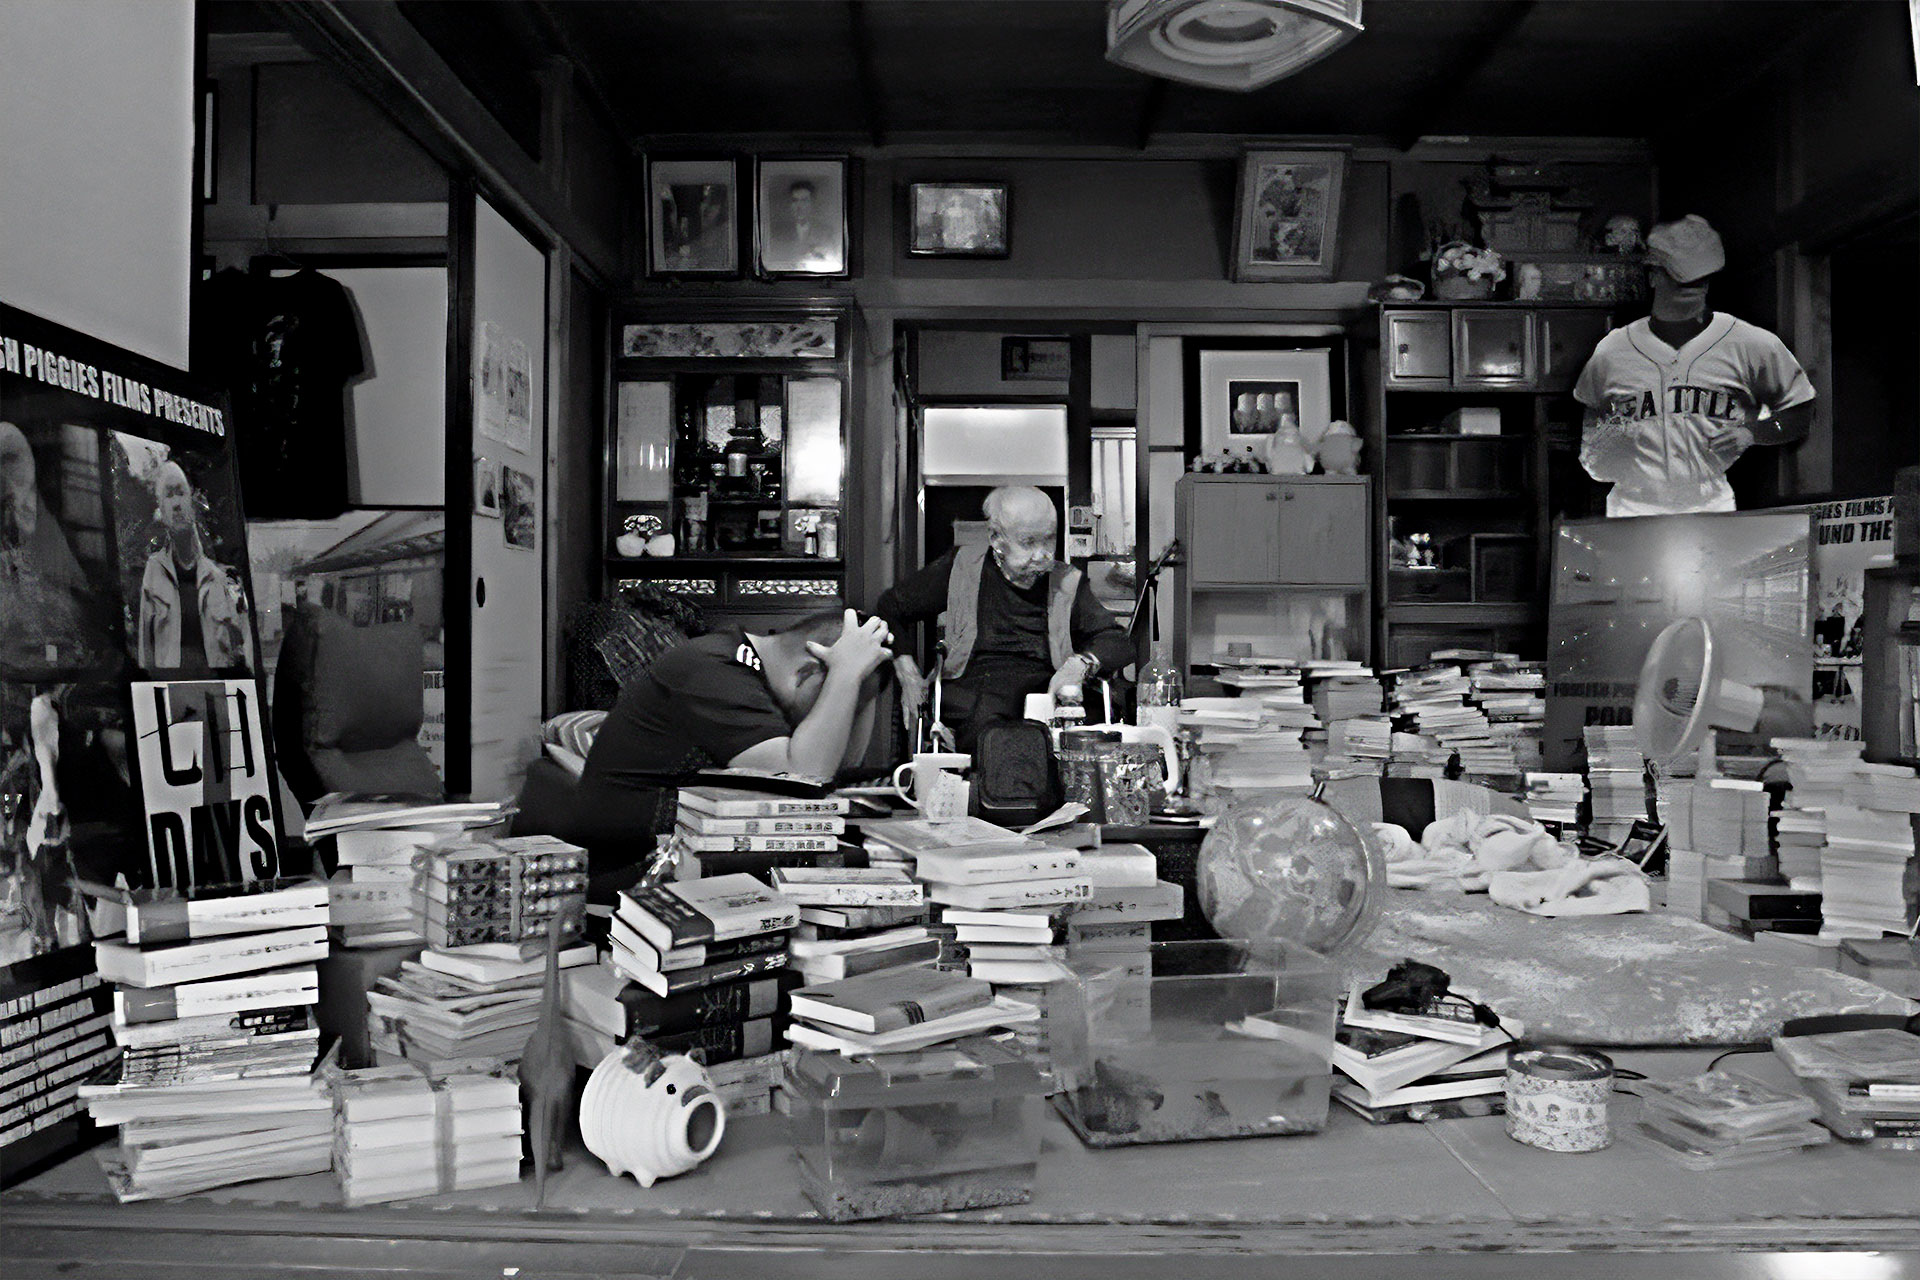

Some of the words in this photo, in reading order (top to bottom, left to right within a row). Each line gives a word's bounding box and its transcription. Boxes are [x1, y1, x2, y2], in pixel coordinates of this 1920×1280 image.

[23, 343, 100, 399] PIGGIES
[102, 370, 152, 415] FILMS
[153, 387, 225, 437] PRESENTS
[1860, 520, 1893, 542] THE
[150, 794, 278, 893] DAYS
